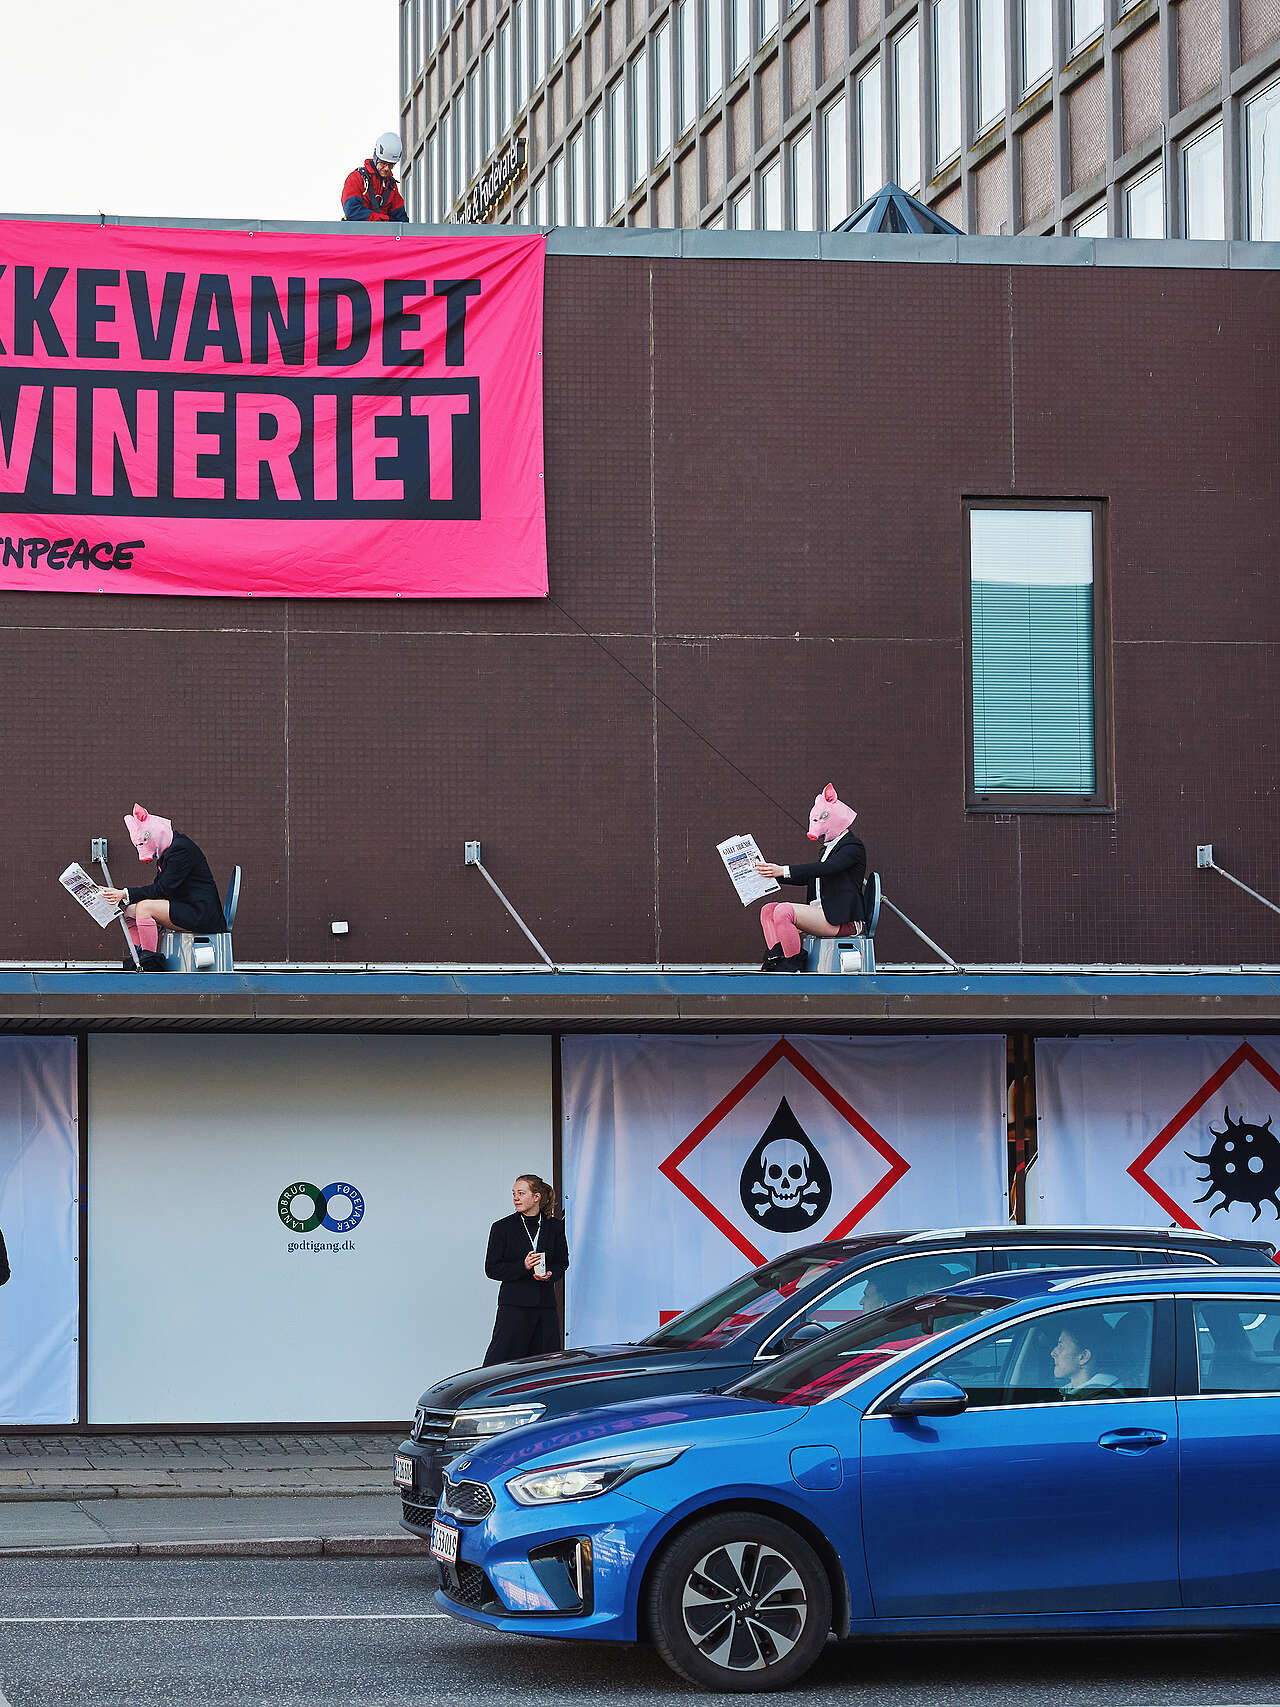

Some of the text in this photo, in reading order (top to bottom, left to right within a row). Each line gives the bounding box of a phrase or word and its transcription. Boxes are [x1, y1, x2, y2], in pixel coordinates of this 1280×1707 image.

[280, 1184, 306, 1231] LANDBRUG
[337, 1184, 363, 1231] FØDEVARER
[287, 1239, 356, 1253] godtigang.dk
